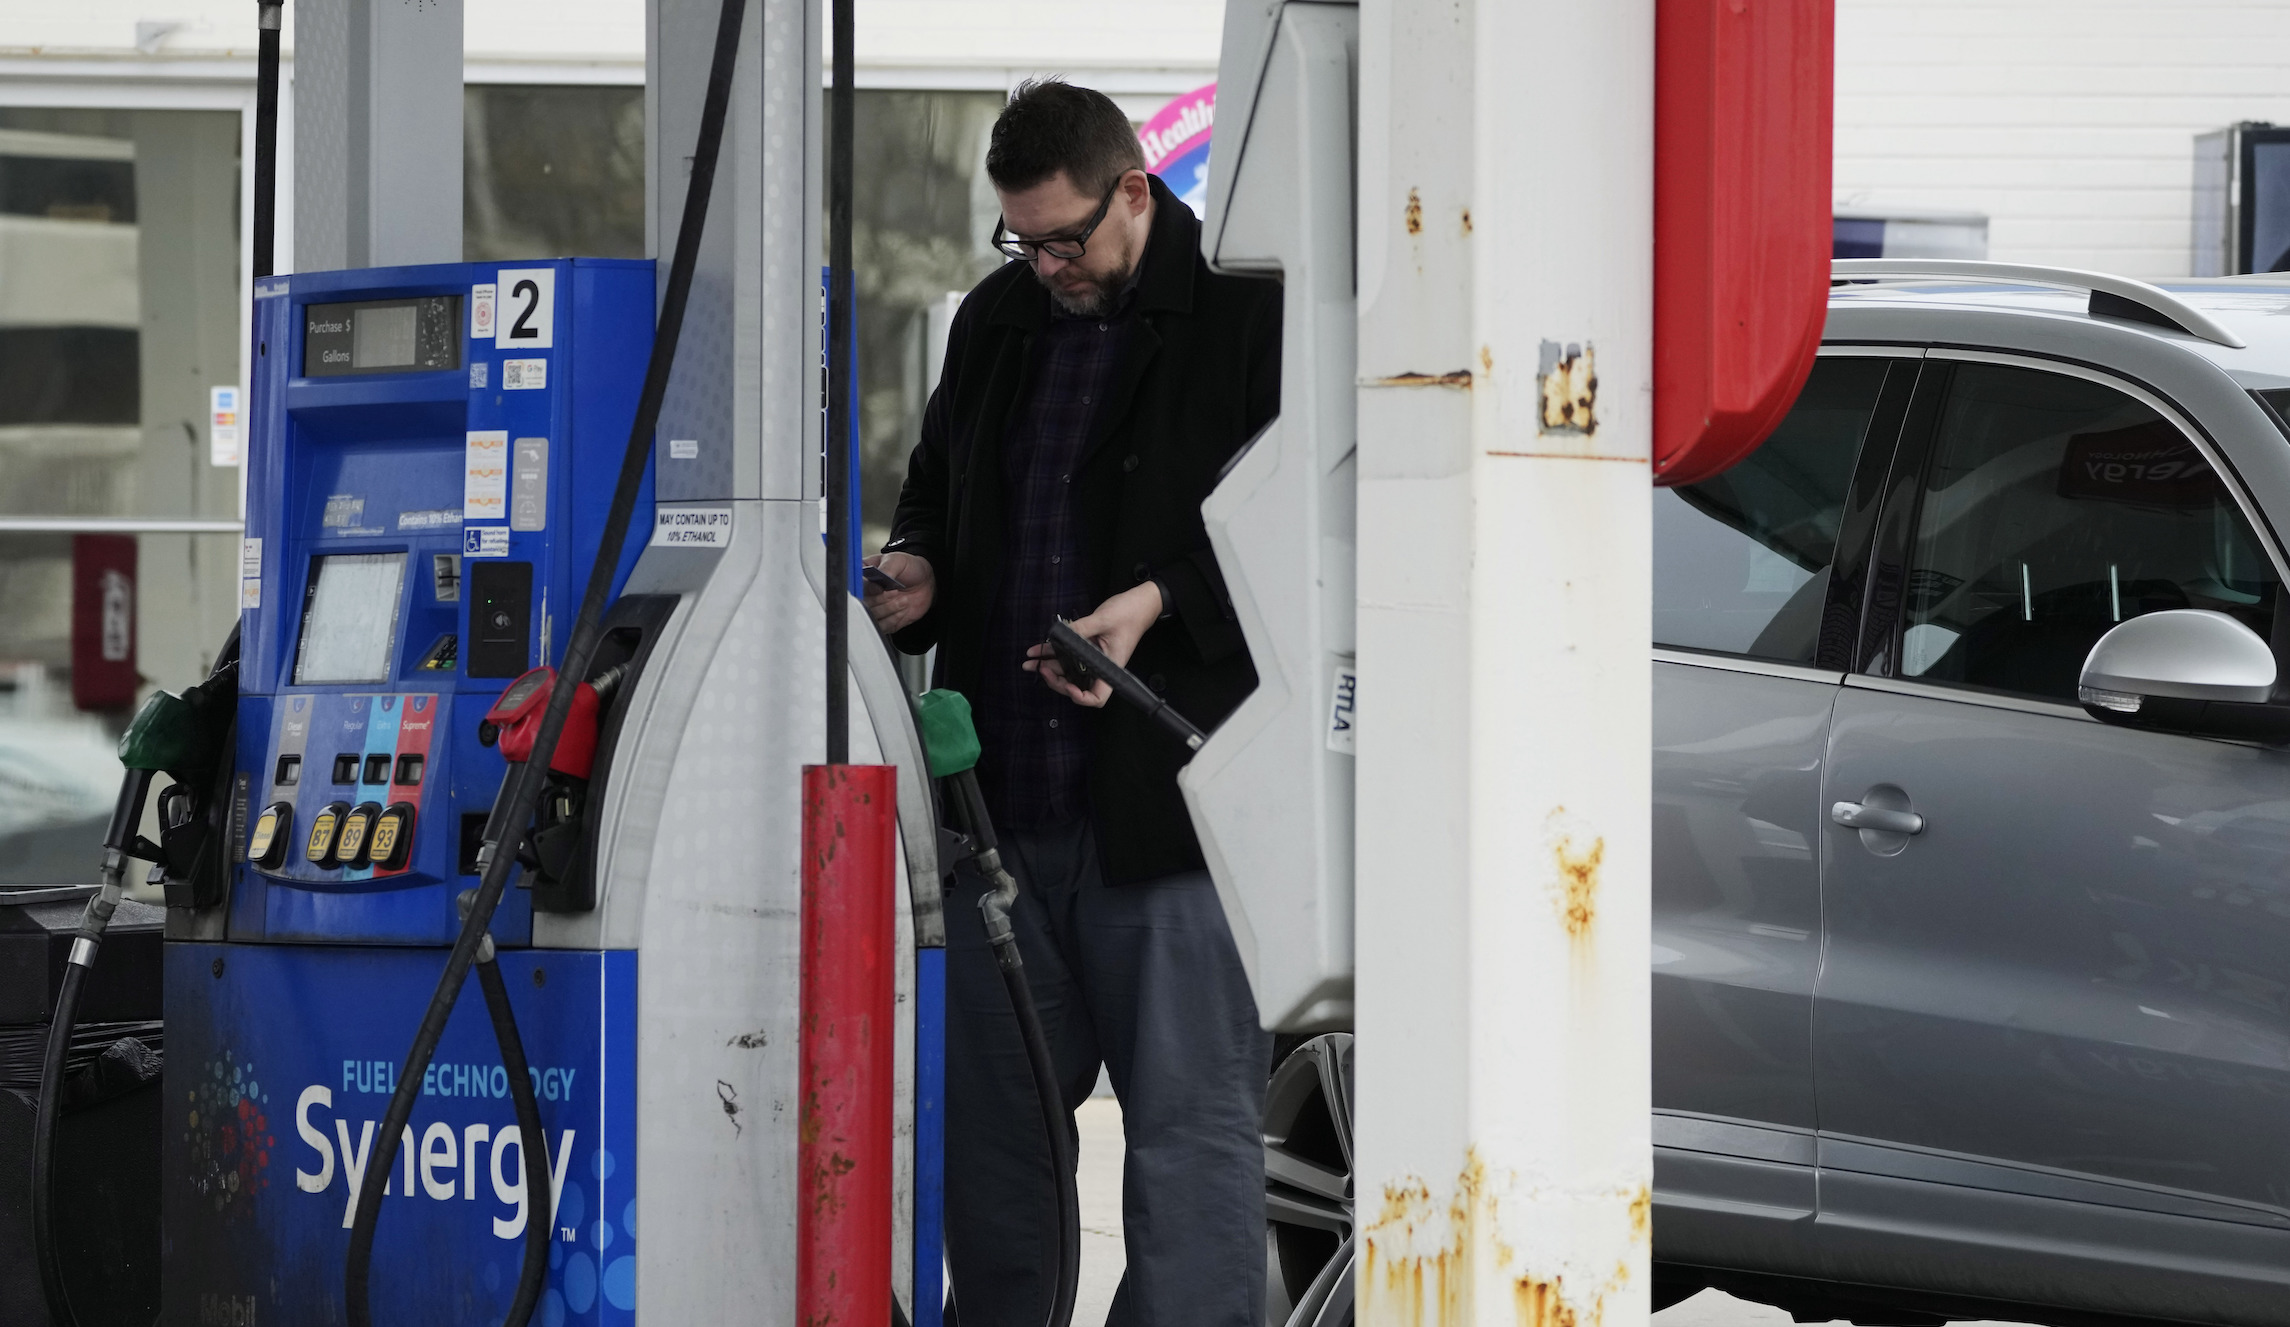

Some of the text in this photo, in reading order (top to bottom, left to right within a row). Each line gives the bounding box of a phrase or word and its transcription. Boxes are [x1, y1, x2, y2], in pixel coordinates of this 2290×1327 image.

[510, 279, 540, 339] 2
[309, 318, 351, 334] Purchase $
[323, 350, 350, 363] Gallons
[399, 514, 428, 526] Contains
[659, 514, 729, 525] MAY CONTAIN UP TO
[667, 531, 716, 542] 10% ETHANOL
[1333, 674, 1356, 731] RTLA
[343, 720, 363, 732] Regular
[312, 828, 331, 847] 87
[343, 828, 361, 848] 89
[376, 828, 394, 848] 93
[343, 1060, 576, 1101] FUEL ECHNOOGY
[561, 1227, 576, 1242] TM
